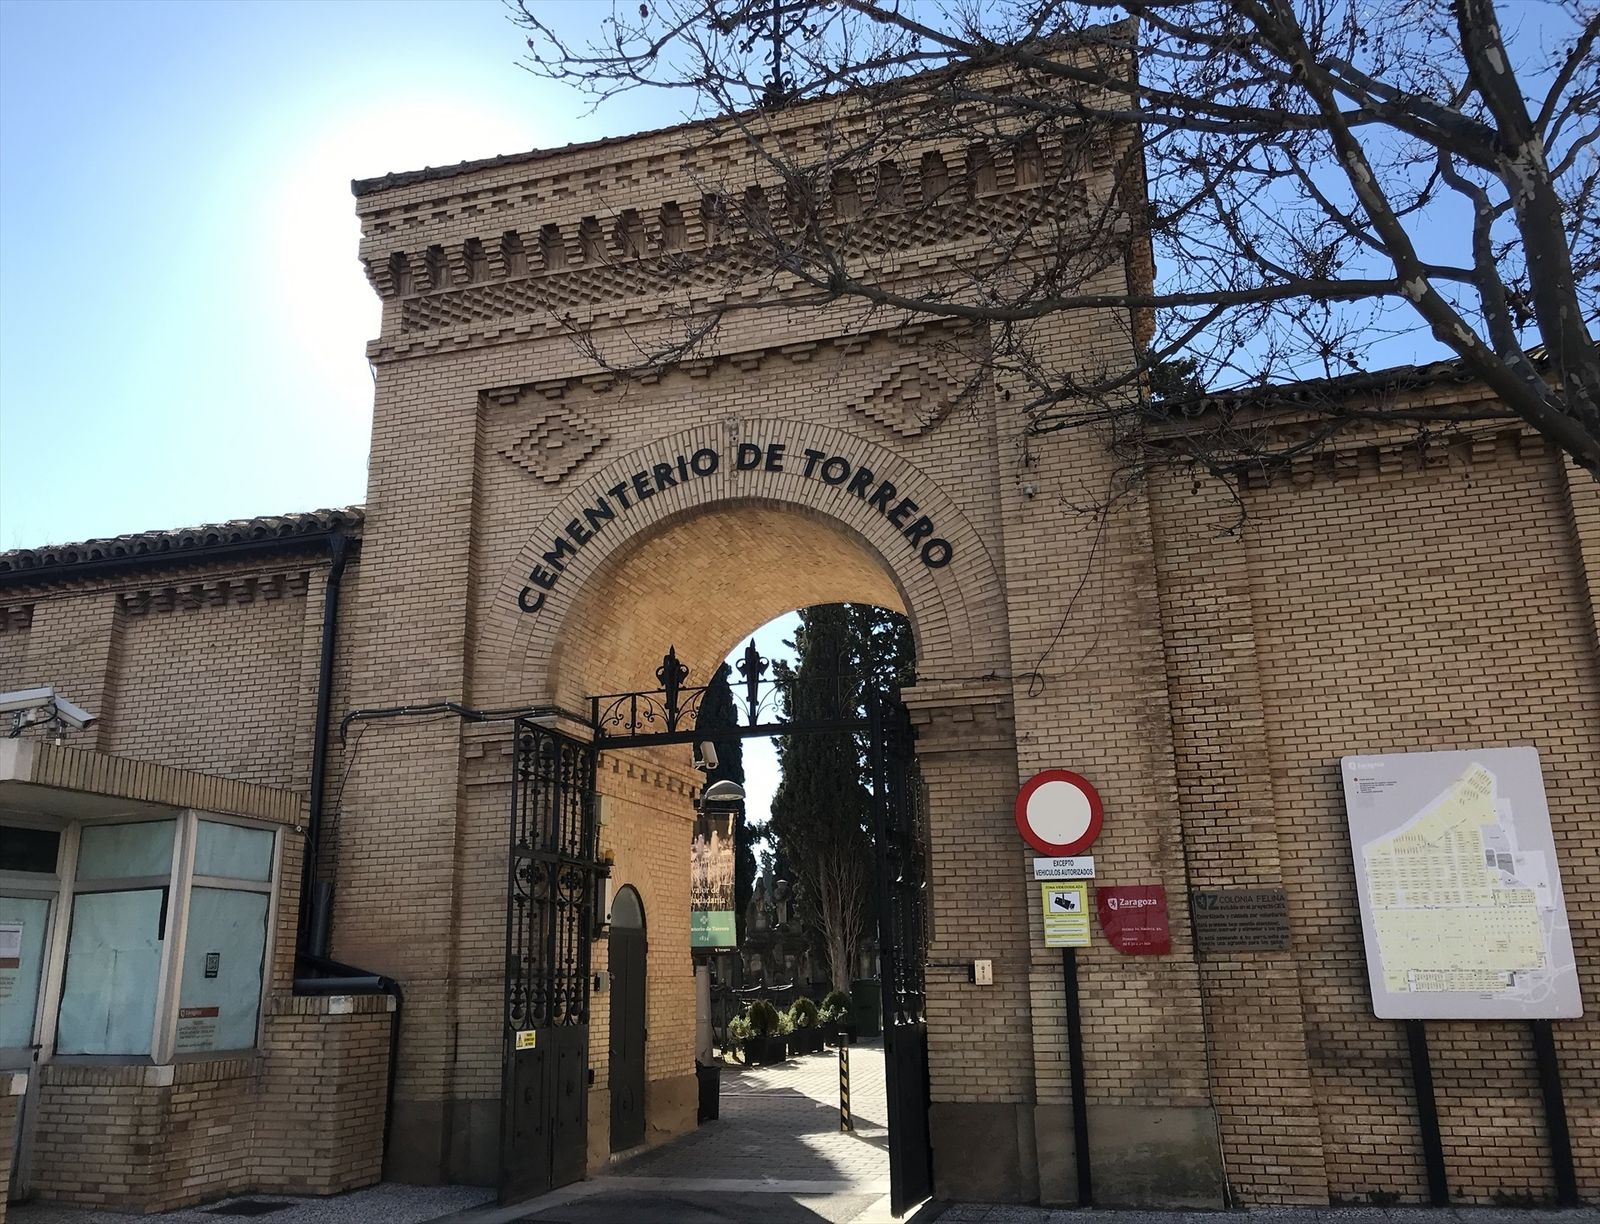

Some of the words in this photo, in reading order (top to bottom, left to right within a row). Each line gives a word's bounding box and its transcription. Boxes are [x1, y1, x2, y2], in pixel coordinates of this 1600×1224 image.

[518, 448, 719, 613] CEMENTERIO
[737, 443, 786, 472] DE
[802, 448, 953, 569] TORRERO
[1061, 868, 1093, 876] AUTORIZADOS
[1120, 898, 1157, 908] Zaragoza
[1256, 894, 1285, 903] FELINA
